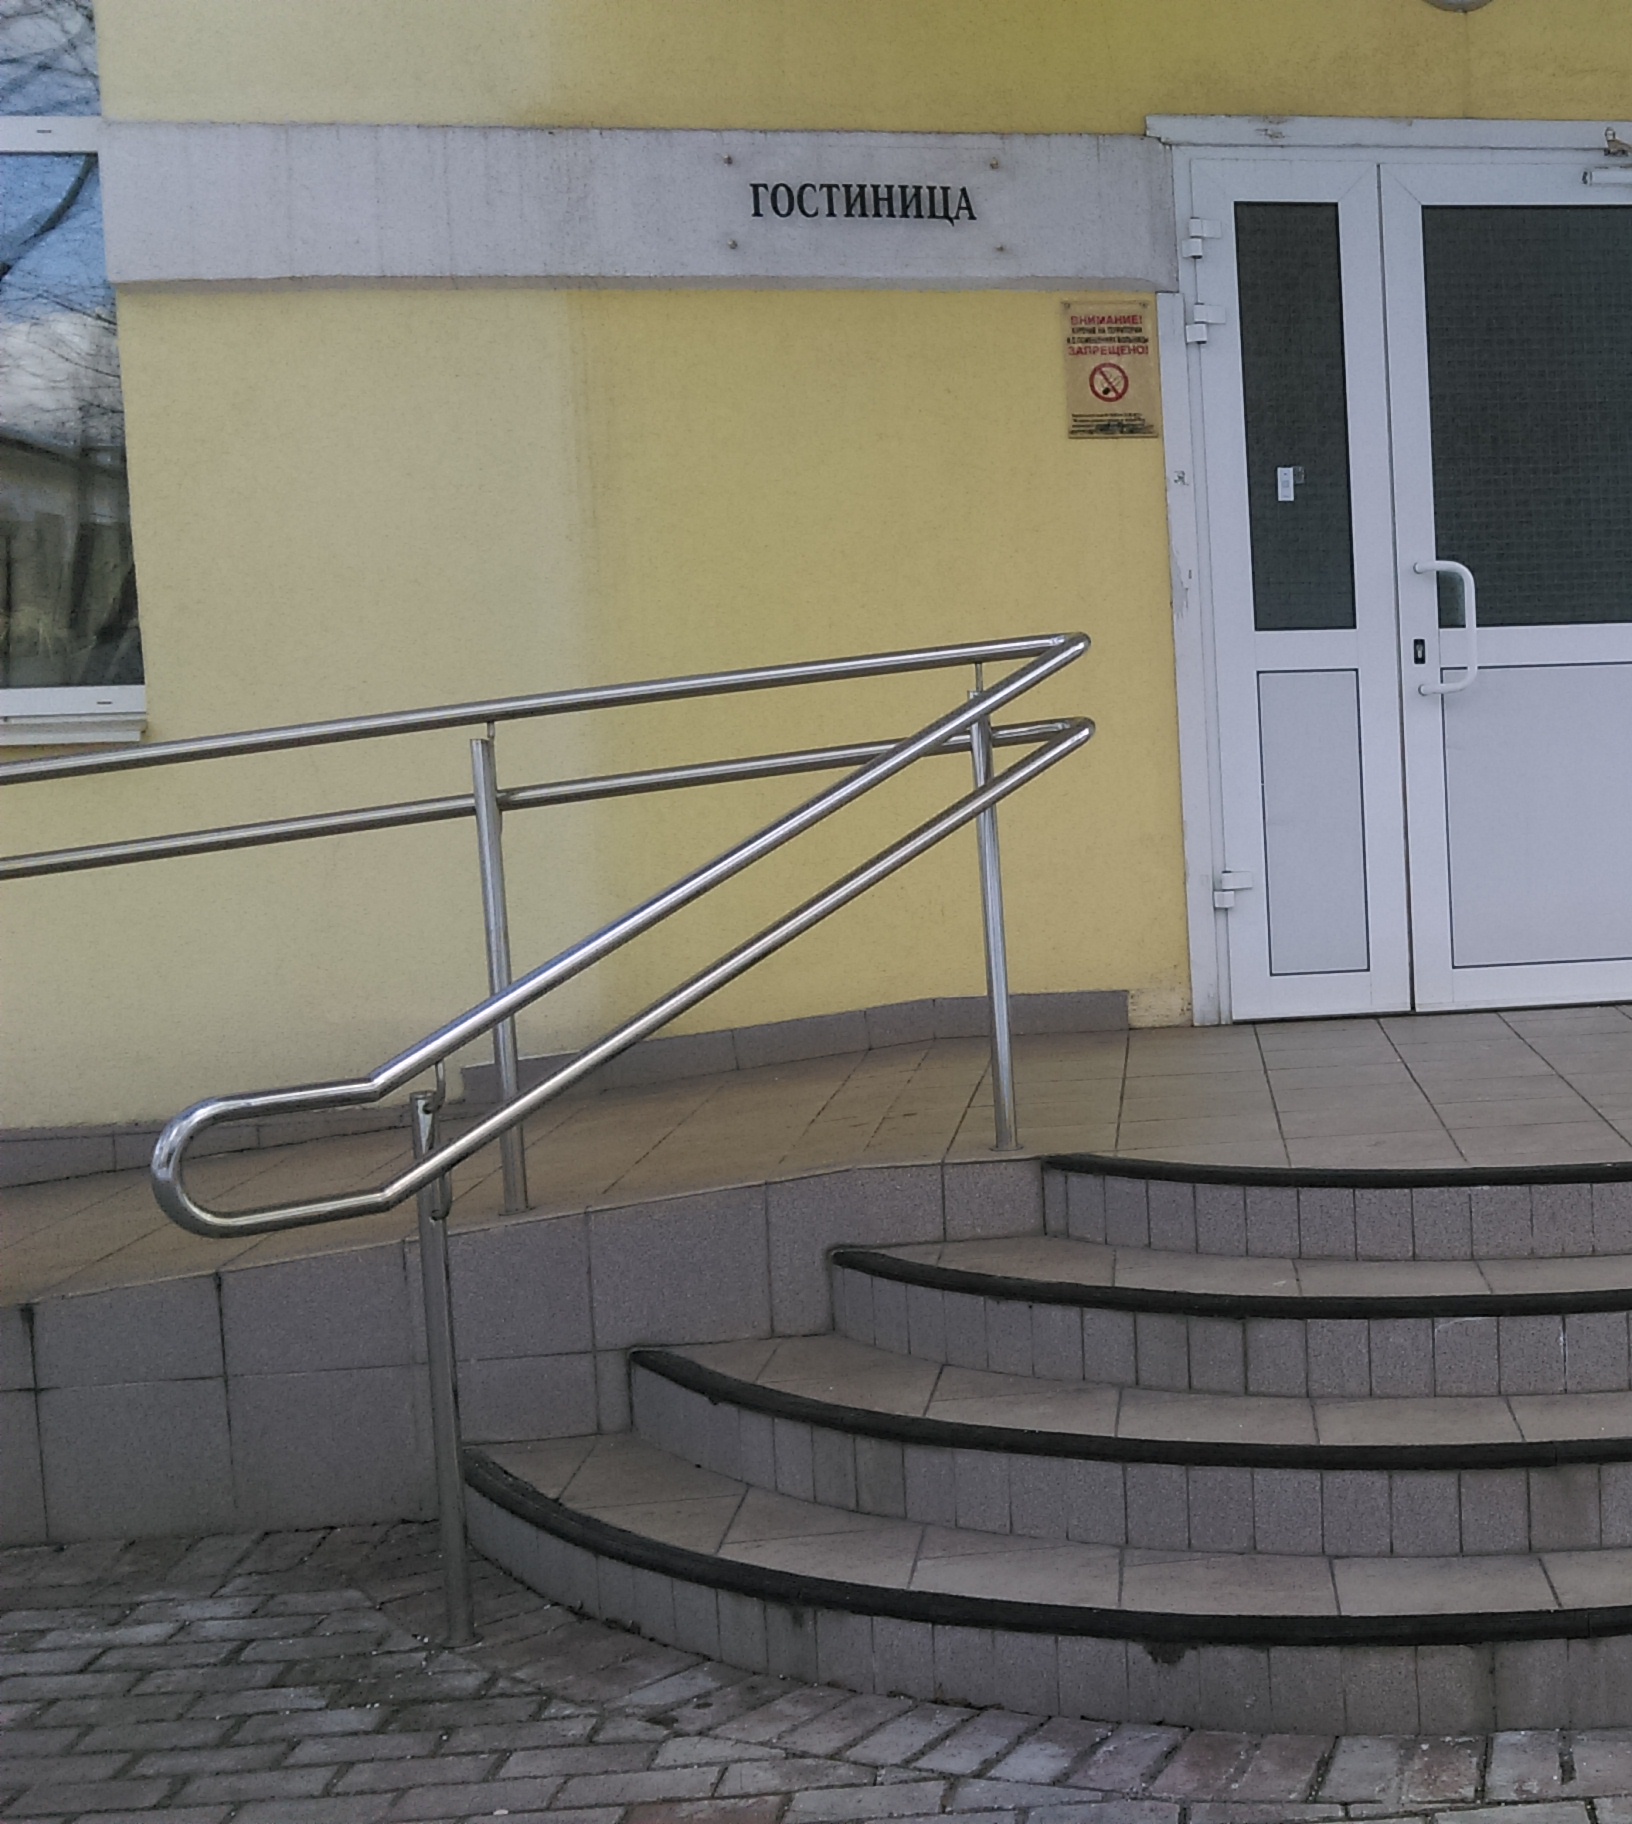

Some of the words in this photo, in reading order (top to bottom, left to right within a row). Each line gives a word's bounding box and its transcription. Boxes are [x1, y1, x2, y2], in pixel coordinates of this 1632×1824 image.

[749, 182, 977, 226] ГОСТИНИЦА
[1070, 314, 1143, 325] ВНИМАНИЕ!
[1068, 344, 1149, 356] ЗАПРЕЩЕНО!
